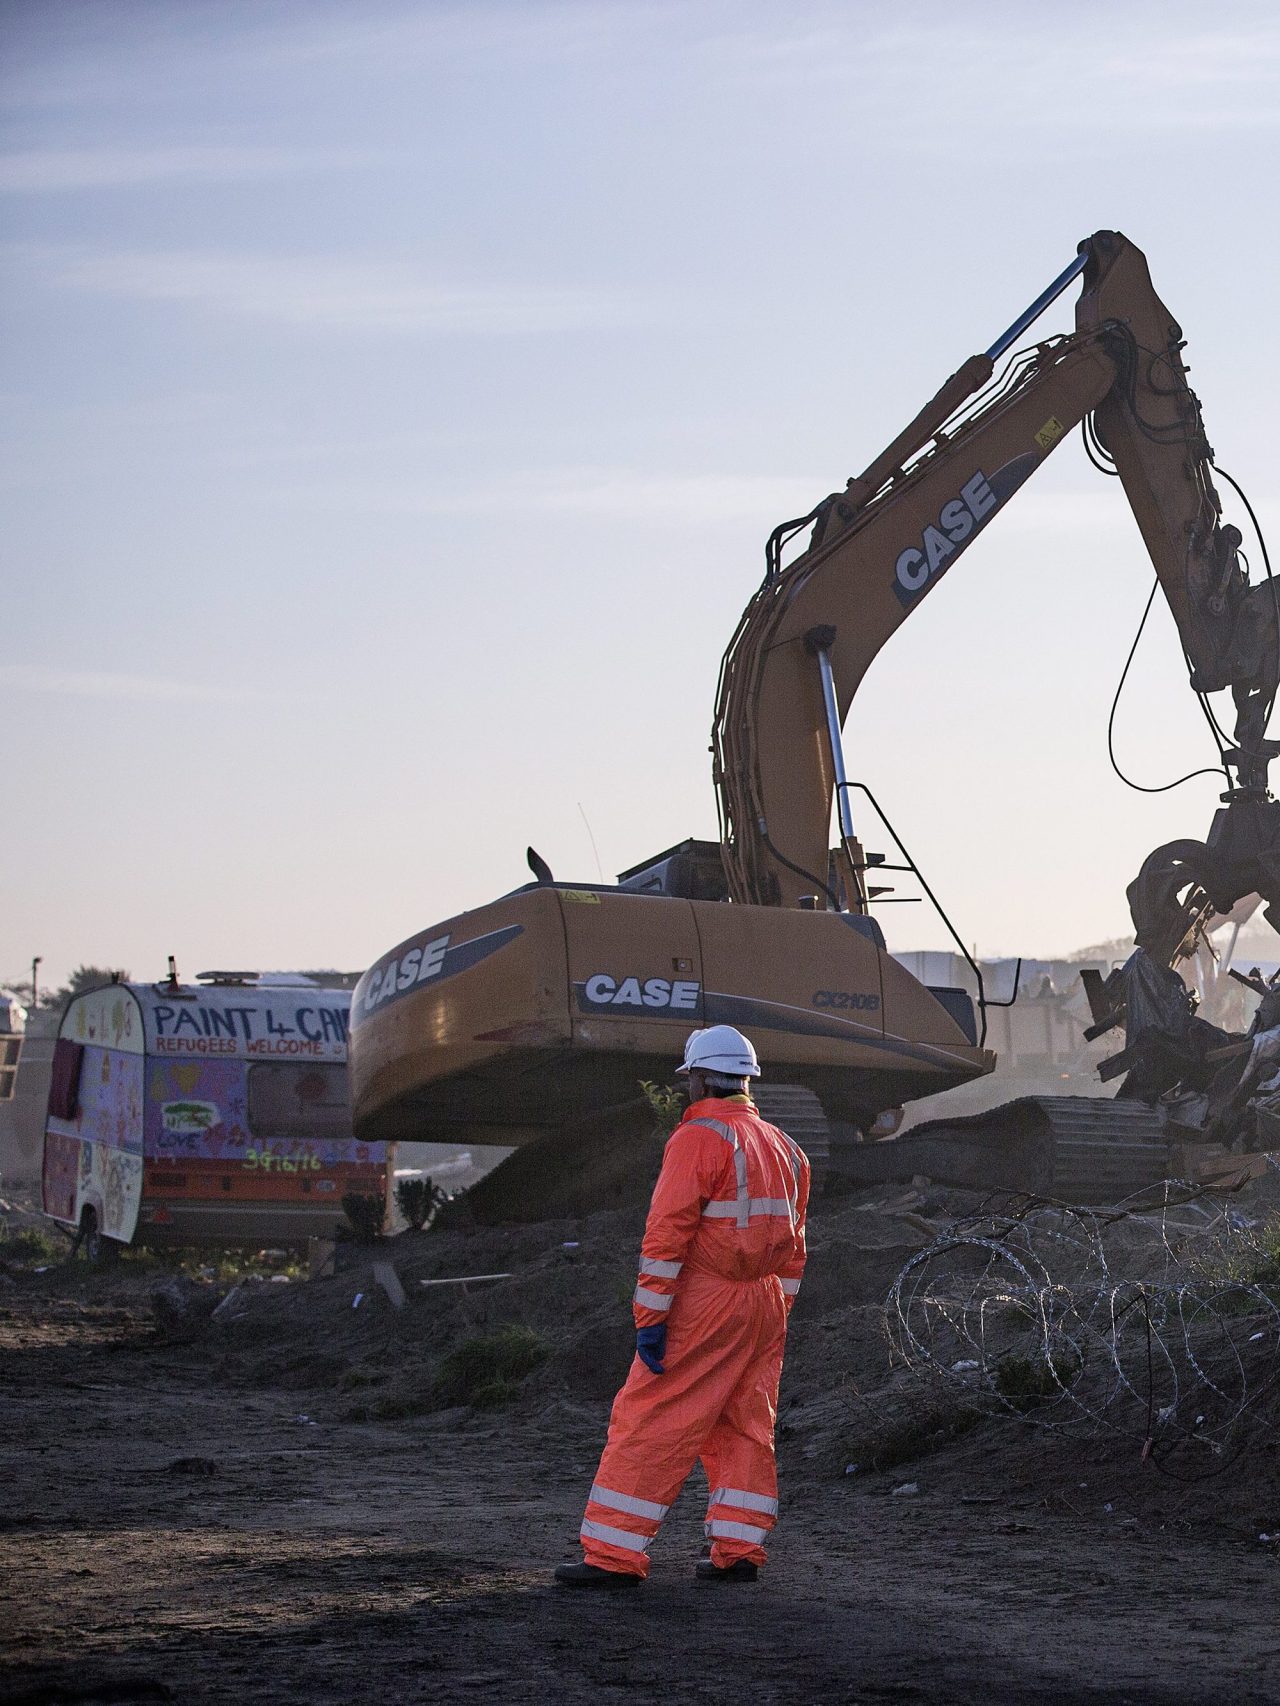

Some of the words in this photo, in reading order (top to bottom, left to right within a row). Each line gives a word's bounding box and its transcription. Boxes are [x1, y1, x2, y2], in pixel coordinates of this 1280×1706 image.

[896, 471, 997, 590] CASE
[364, 934, 450, 1010] CASE
[585, 974, 700, 1009] CASE
[811, 989, 880, 1011] CX210B
[153, 1006, 258, 1040] PAINT
[266, 1009, 295, 1037] 4
[156, 1037, 236, 1053] REFUGEES
[246, 1038, 323, 1055] WELCOME
